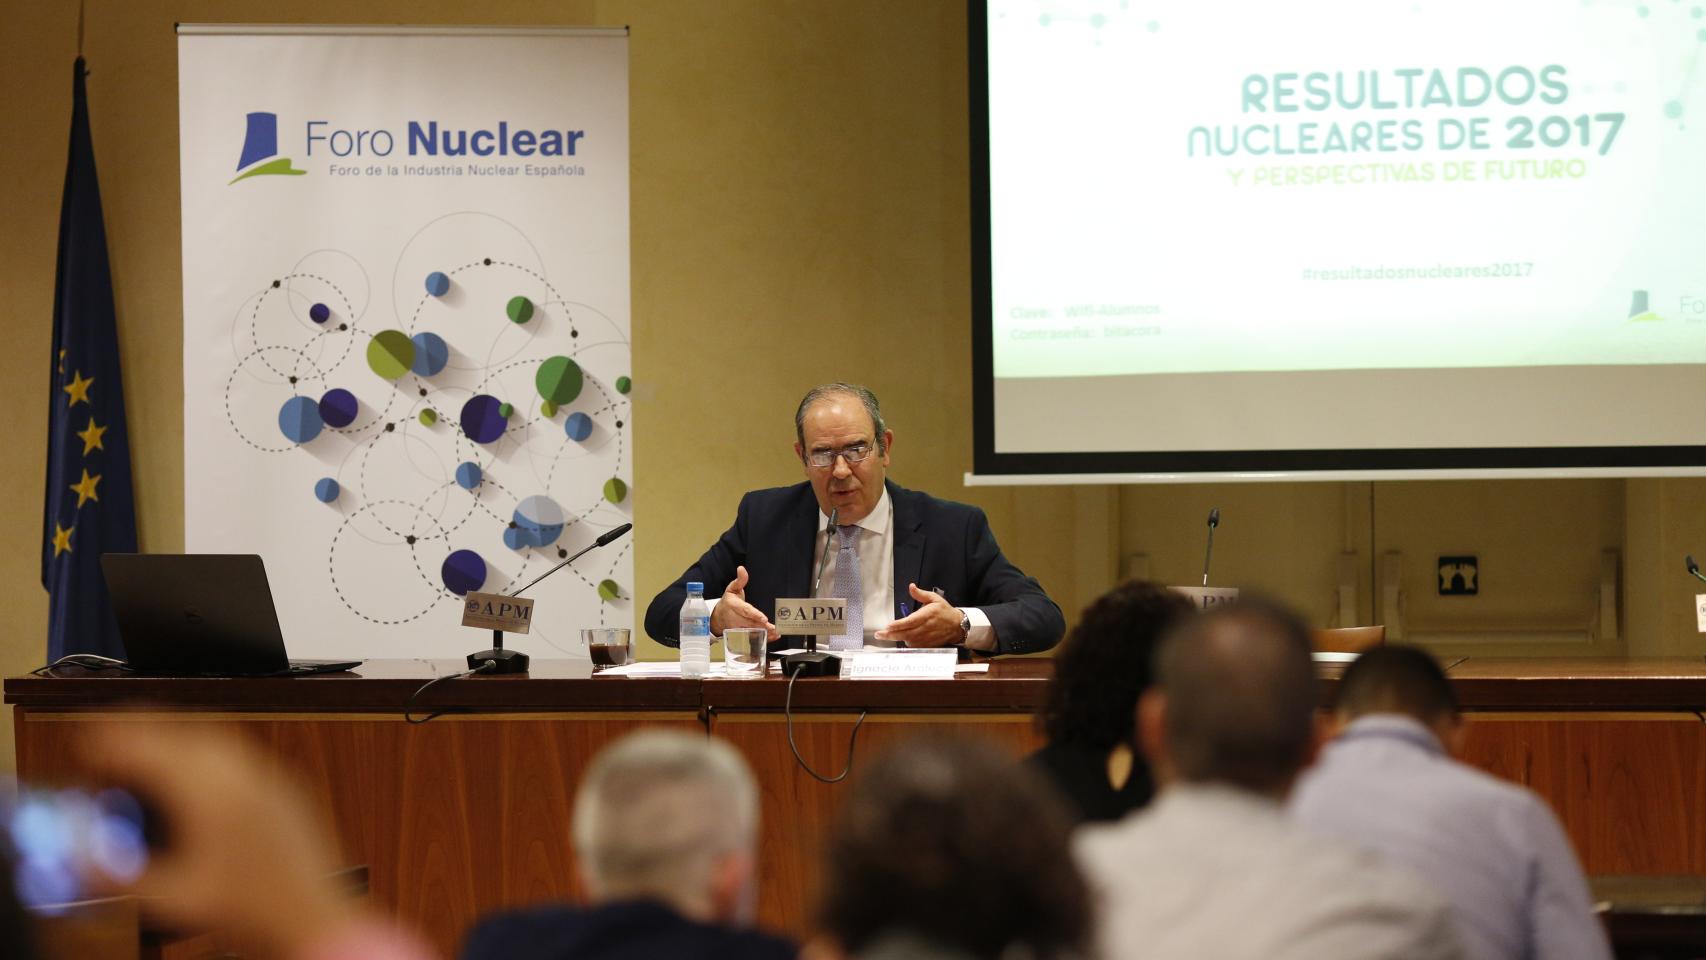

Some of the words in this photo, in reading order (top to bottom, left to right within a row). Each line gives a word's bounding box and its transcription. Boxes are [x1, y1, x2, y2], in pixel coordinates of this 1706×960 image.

[1241, 63, 1569, 113] RESULTADOS
[306, 121, 393, 157] Foro
[408, 121, 584, 157] Nuclear
[1187, 117, 1424, 157] NUCLEARES
[1437, 117, 1491, 151] DE
[1504, 112, 1626, 157] 2017
[329, 164, 360, 176] Foro
[365, 164, 382, 176] de
[387, 164, 399, 176] la
[404, 164, 463, 176] Industria
[468, 164, 519, 176] Nuclear
[525, 164, 585, 178] Española
[1226, 167, 1244, 186] Y
[1254, 161, 1435, 186] PERSPECTIVAS
[1443, 160, 1476, 182] DE
[1485, 158, 1586, 180] FUTURO
[1302, 262, 1535, 280] #resultadosnucleares2017
[481, 601, 531, 620] APM
[794, 606, 844, 620] APM
